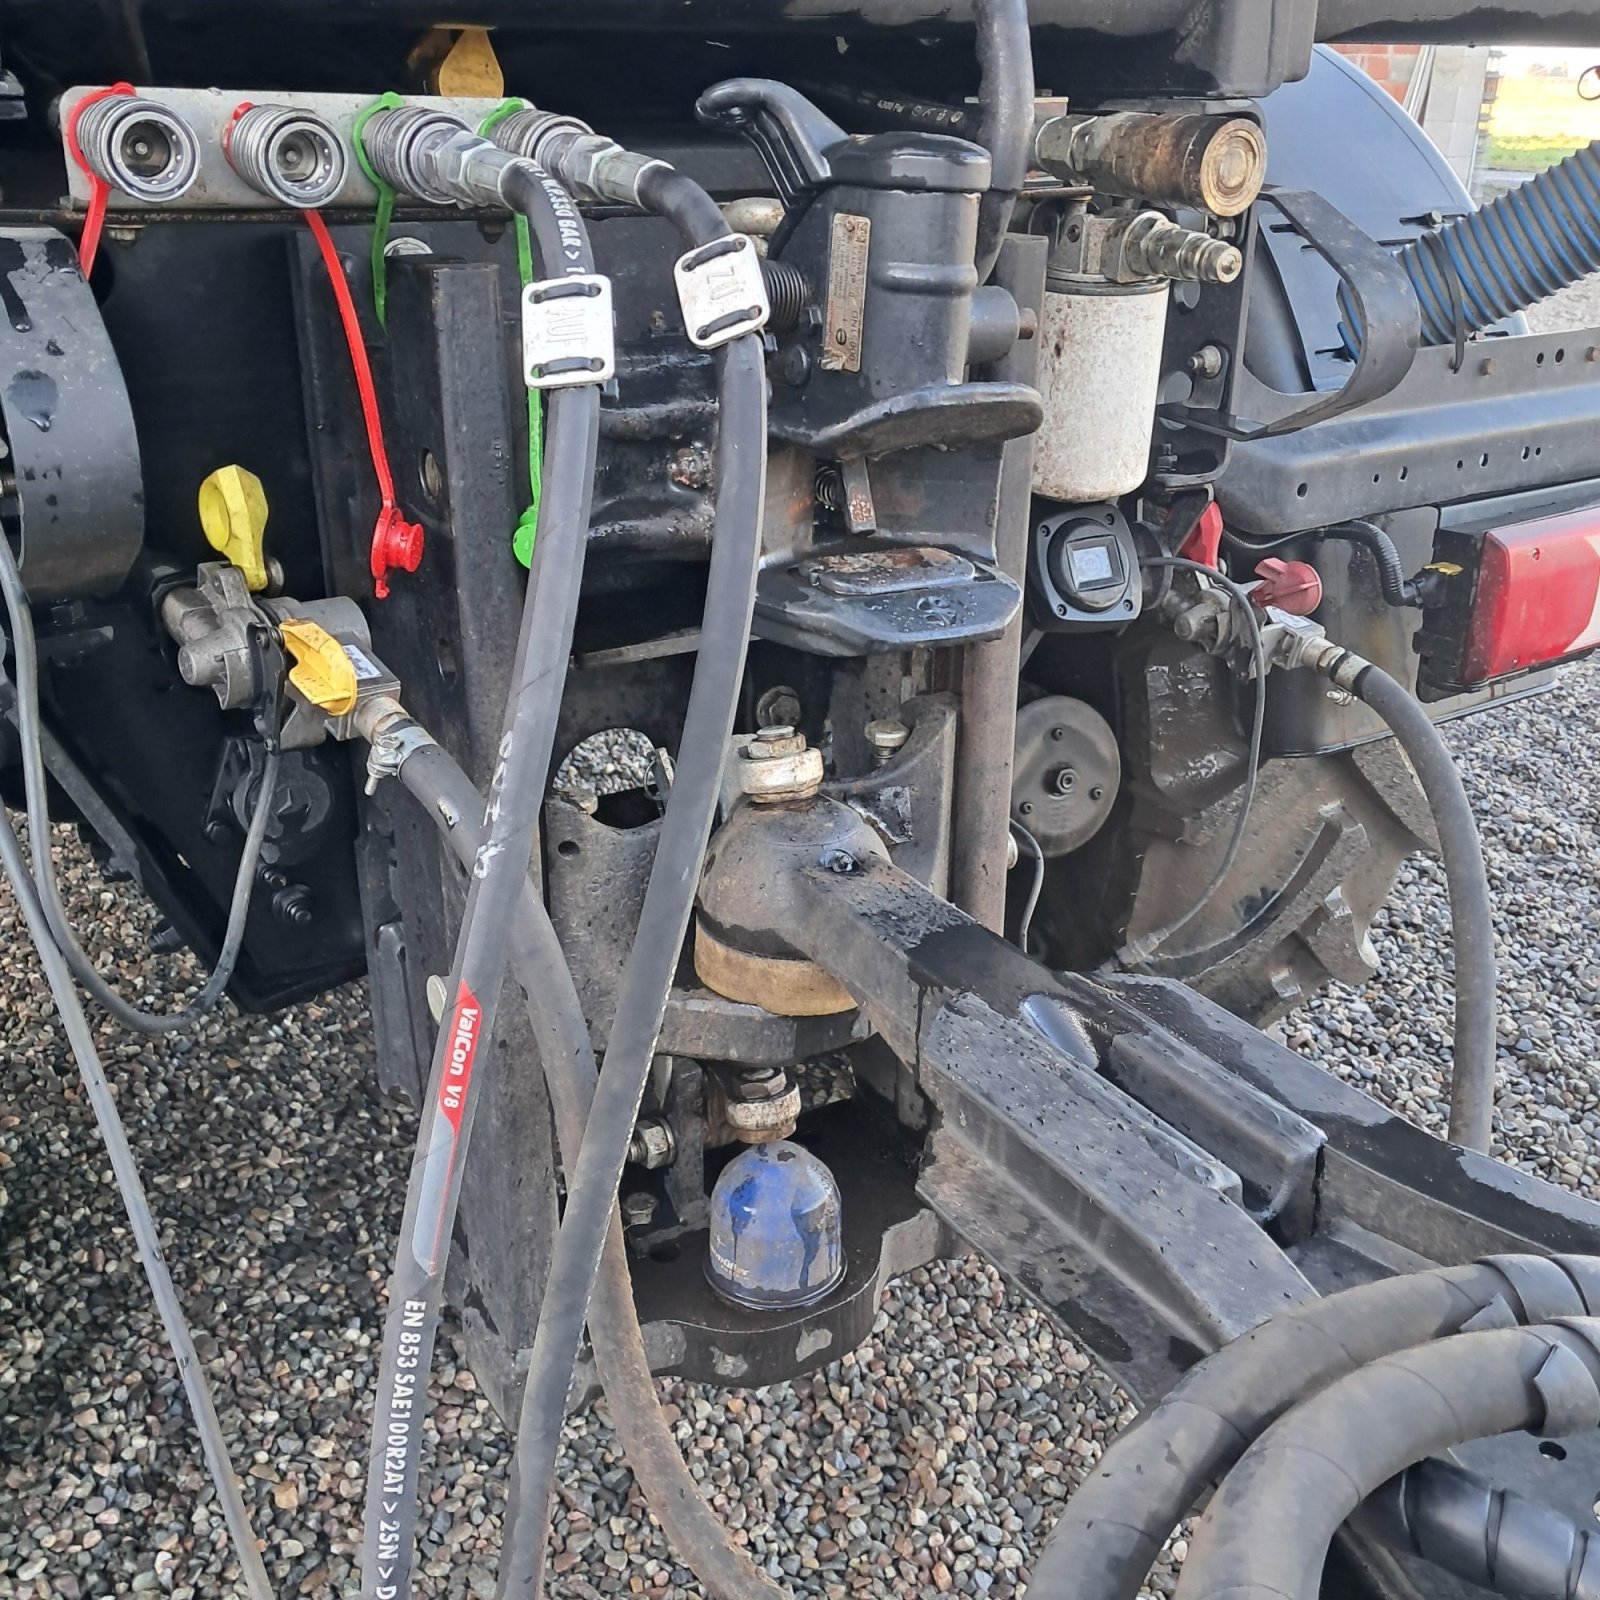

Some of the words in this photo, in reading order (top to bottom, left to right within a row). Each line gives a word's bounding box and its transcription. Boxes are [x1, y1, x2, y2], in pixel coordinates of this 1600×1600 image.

[557, 219, 582, 247] BAR
[545, 307, 588, 347] AUF
[449, 1007, 479, 1076] ValCon
[443, 1085, 463, 1109] V8
[402, 1300, 427, 1327] EN
[396, 1332, 422, 1369] 853
[382, 1373, 416, 1495] SAE100R2AT
[377, 1520, 401, 1560] 2SN
